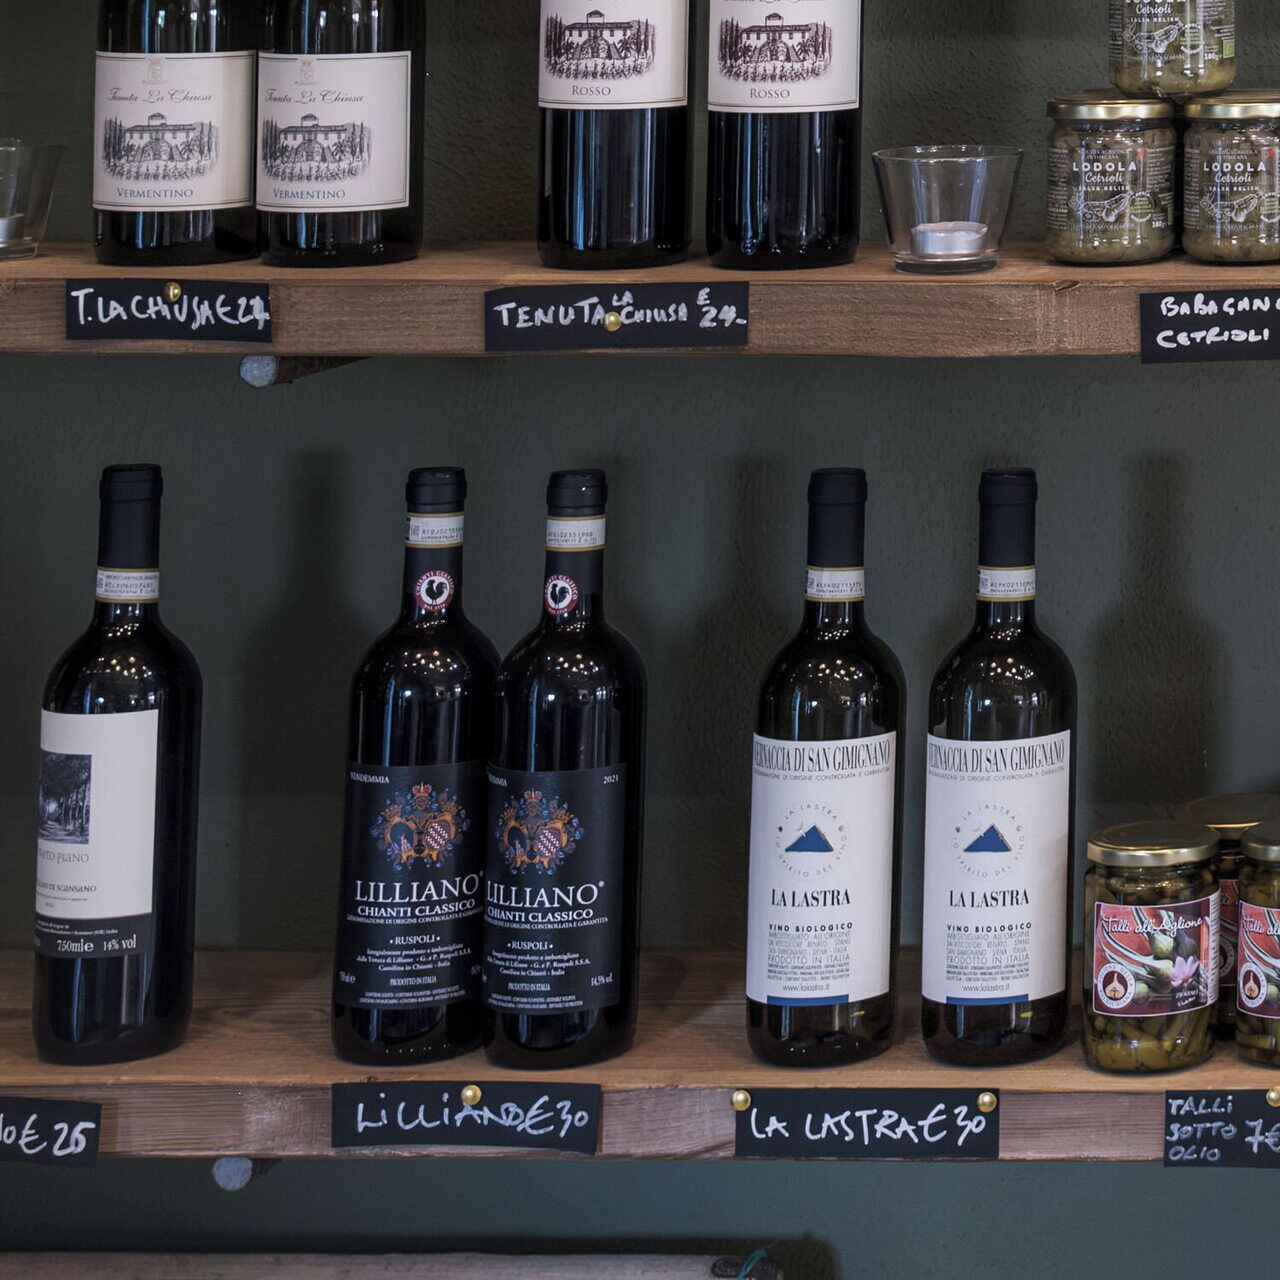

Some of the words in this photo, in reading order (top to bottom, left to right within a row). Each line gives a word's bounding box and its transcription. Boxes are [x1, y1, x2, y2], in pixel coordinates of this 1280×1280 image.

[1072, 162, 1137, 172] LODOLA
[493, 296, 606, 329] TENUTA
[612, 290, 634, 307] LA
[355, 874, 480, 903] LILLIANO
[486, 880, 599, 908] LILLIANO
[771, 888, 787, 907] LA
[791, 888, 851, 908] LASTRA
[949, 889, 966, 908] LA
[970, 889, 1029, 908] LASTRA
[357, 905, 411, 917] CHIANTI
[528, 908, 593, 923] CLASSICO
[750, 1107, 789, 1138] LA
[804, 1107, 918, 1145] LASTRA
